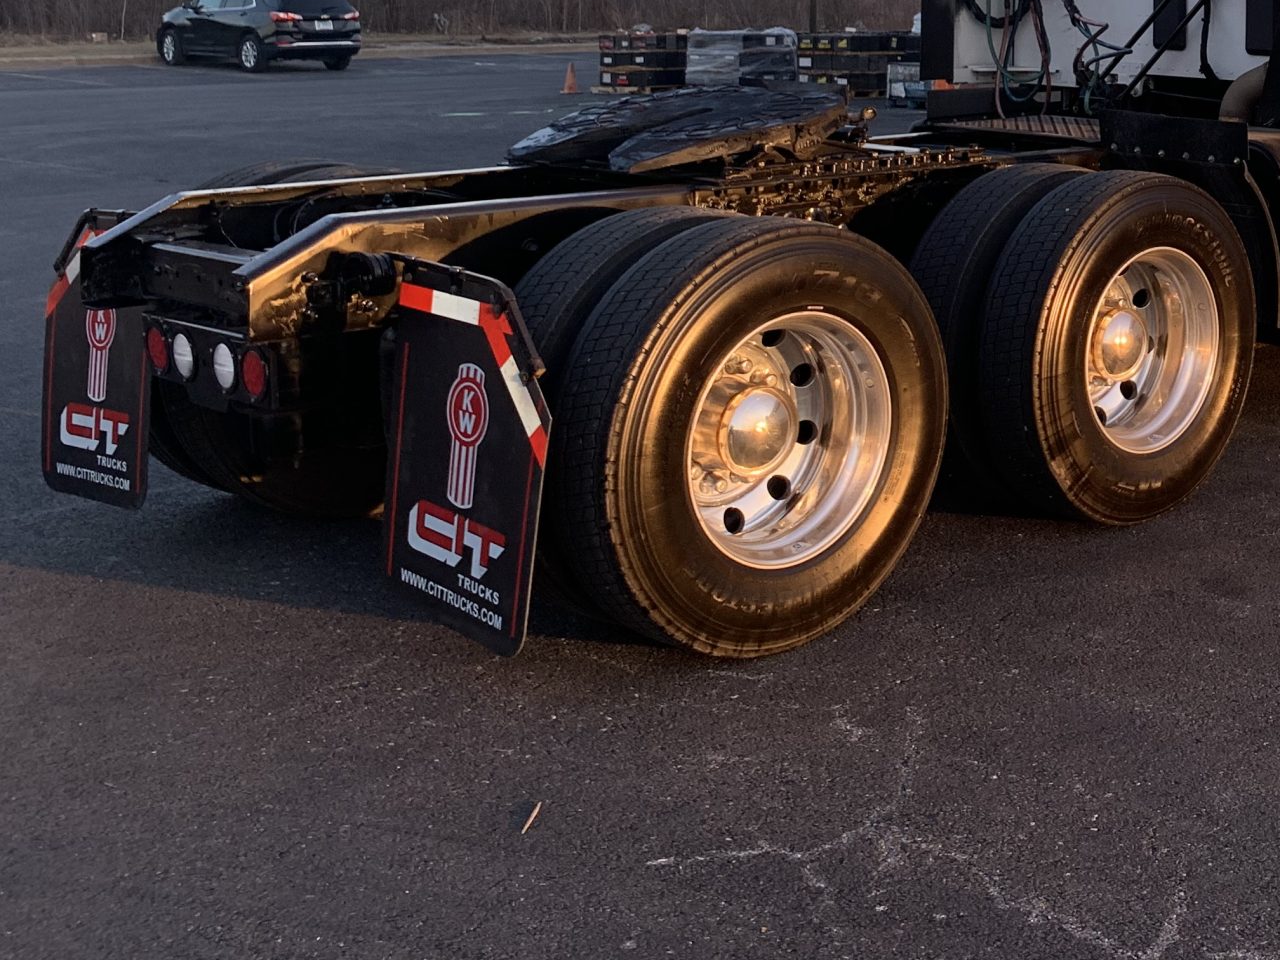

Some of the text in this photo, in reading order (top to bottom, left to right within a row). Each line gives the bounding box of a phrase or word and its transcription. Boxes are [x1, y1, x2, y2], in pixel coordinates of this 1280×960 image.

[60, 402, 129, 455] CIT
[56, 462, 130, 491] WWW.CITTRUCKS.COM
[97, 455, 127, 472] TRUCKS
[408, 499, 505, 580] CIT
[401, 568, 502, 631] WWW.CITTRUCKS.COM
[457, 574, 499, 605] TRUCKS
